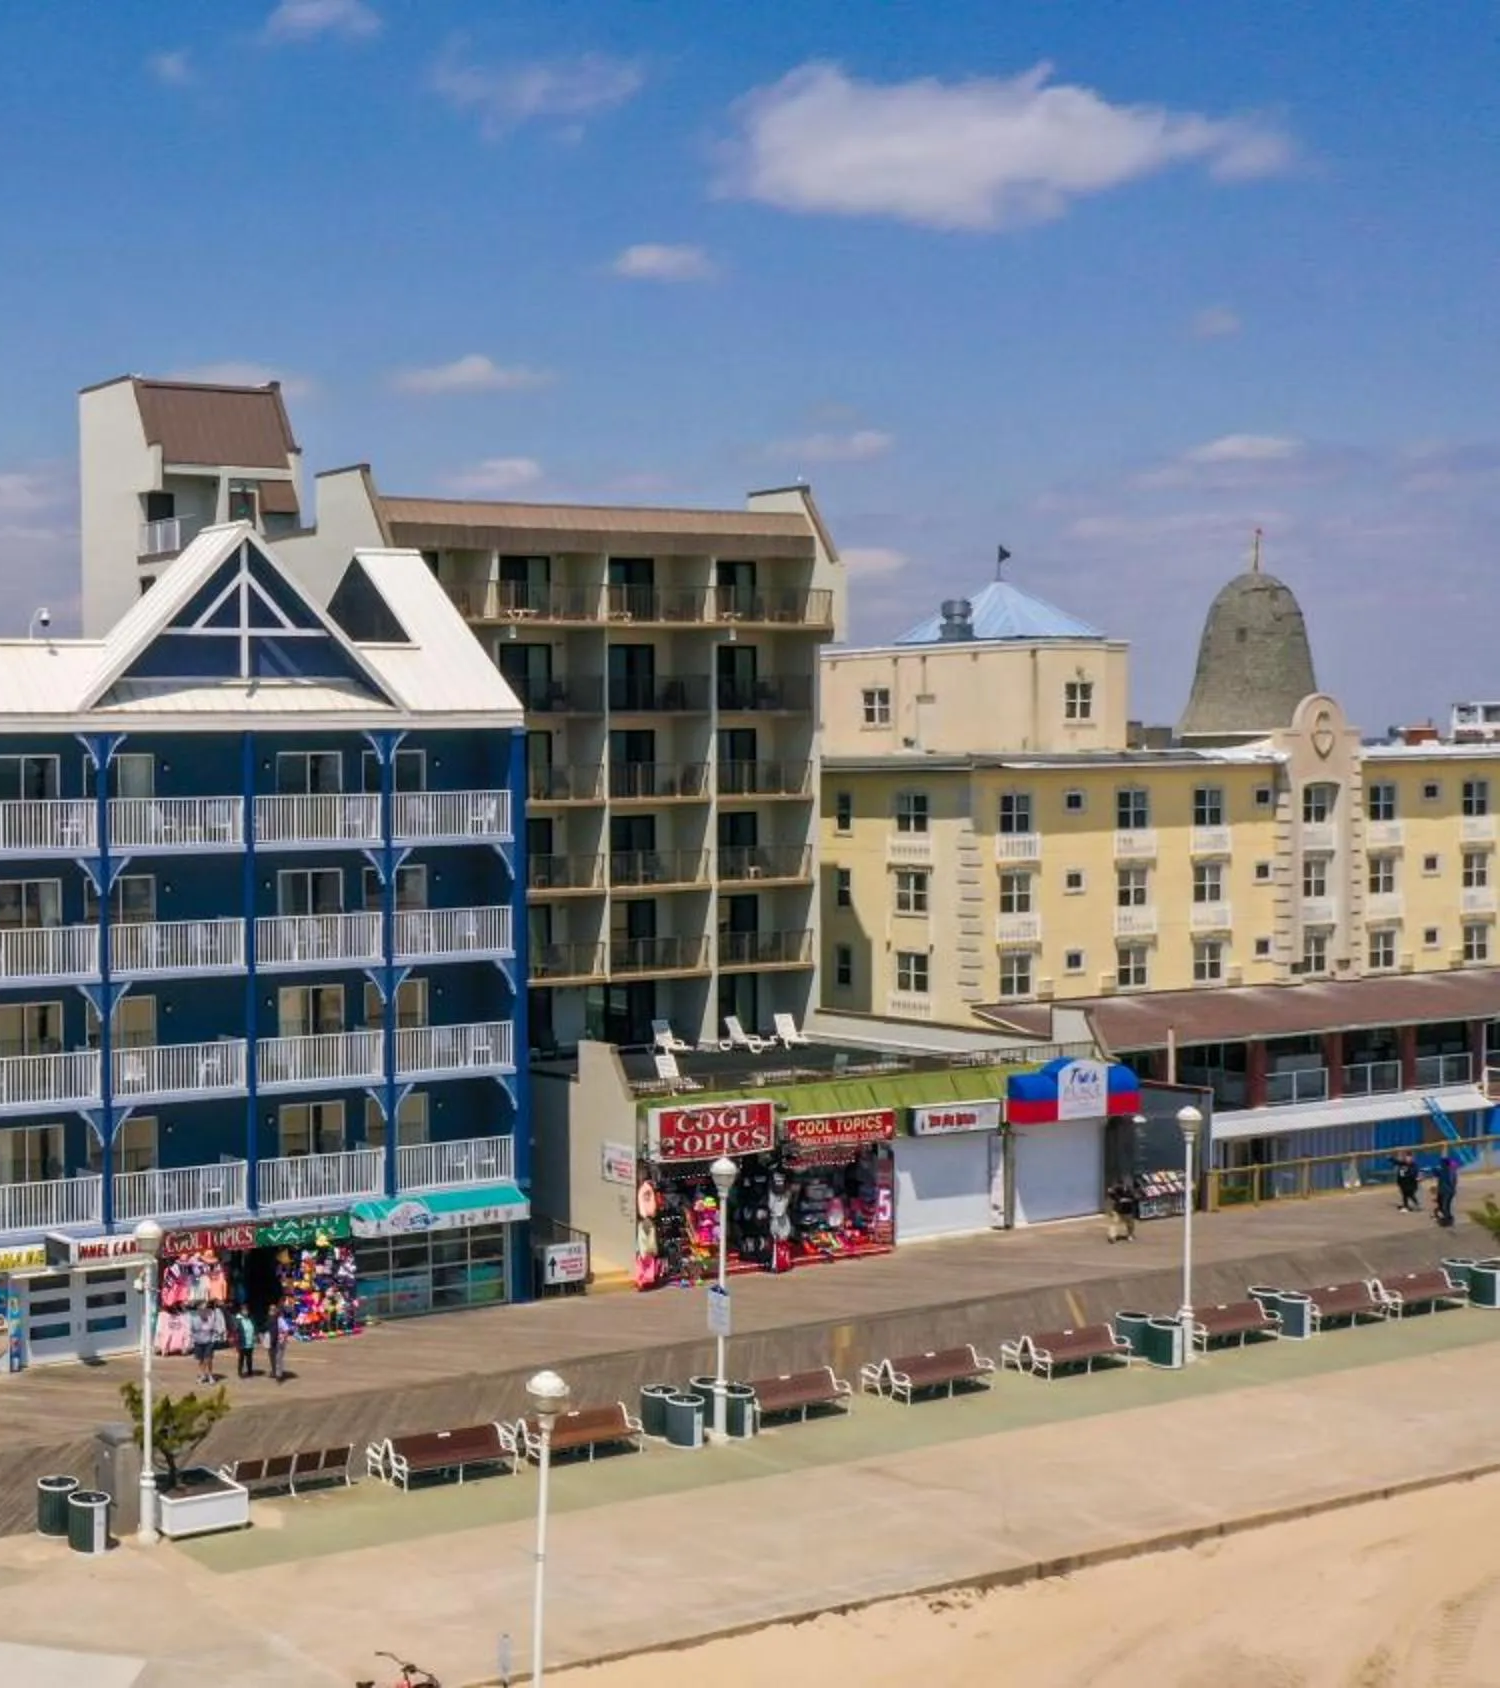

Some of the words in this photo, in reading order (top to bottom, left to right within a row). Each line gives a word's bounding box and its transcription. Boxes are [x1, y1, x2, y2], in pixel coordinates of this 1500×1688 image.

[796, 1119, 833, 1136] COOL
[836, 1114, 884, 1133] TOPICS
[662, 1130, 768, 1155] TOPICS
[165, 1230, 203, 1253] COOL
[204, 1224, 253, 1250] TOPICS
